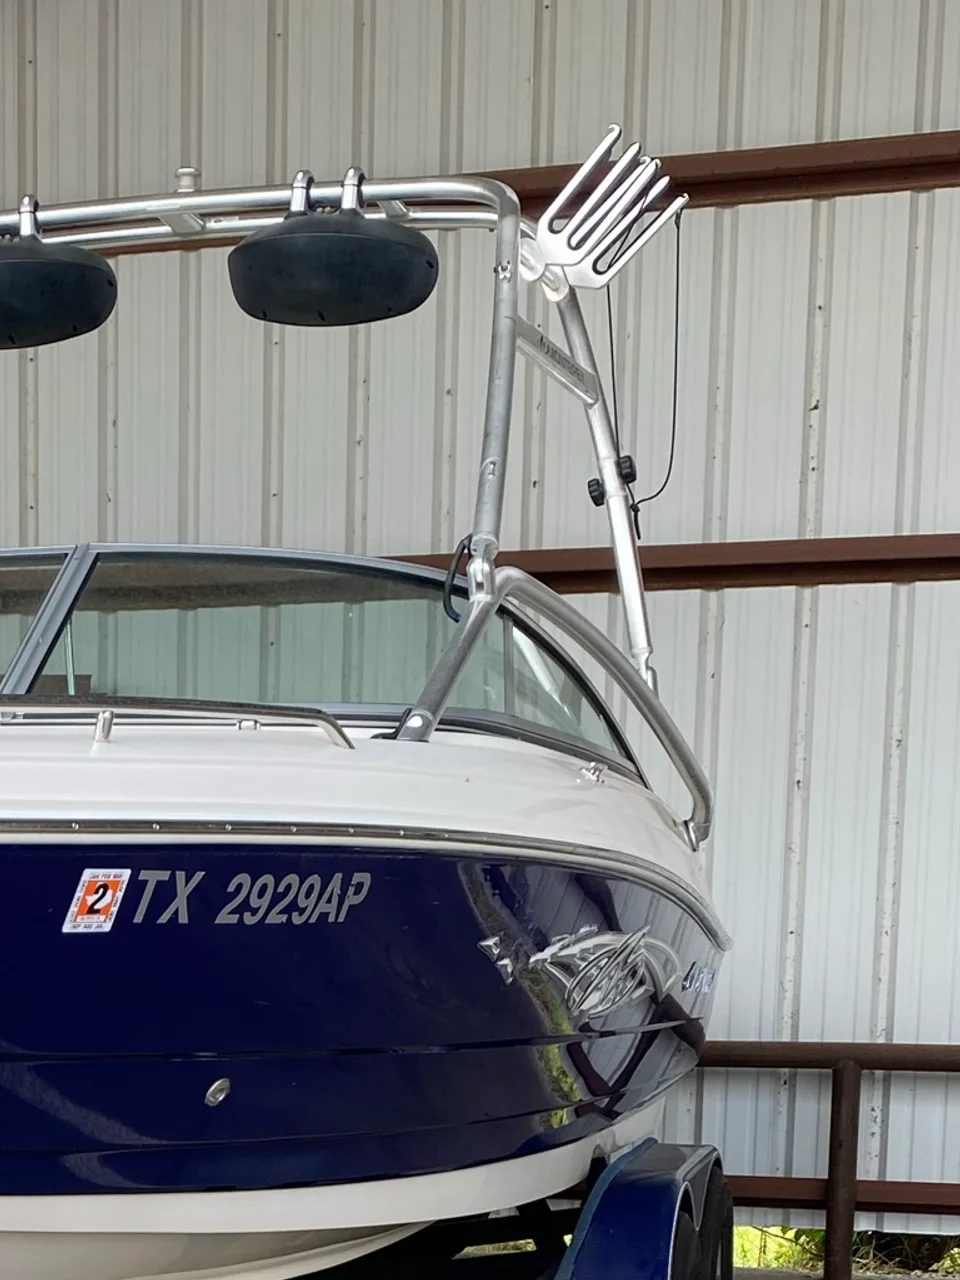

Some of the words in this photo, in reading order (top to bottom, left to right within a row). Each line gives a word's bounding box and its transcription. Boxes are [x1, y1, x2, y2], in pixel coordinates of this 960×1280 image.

[86, 882, 110, 915] 2
[133, 870, 205, 923] TX
[214, 872, 371, 925] 2929AP
